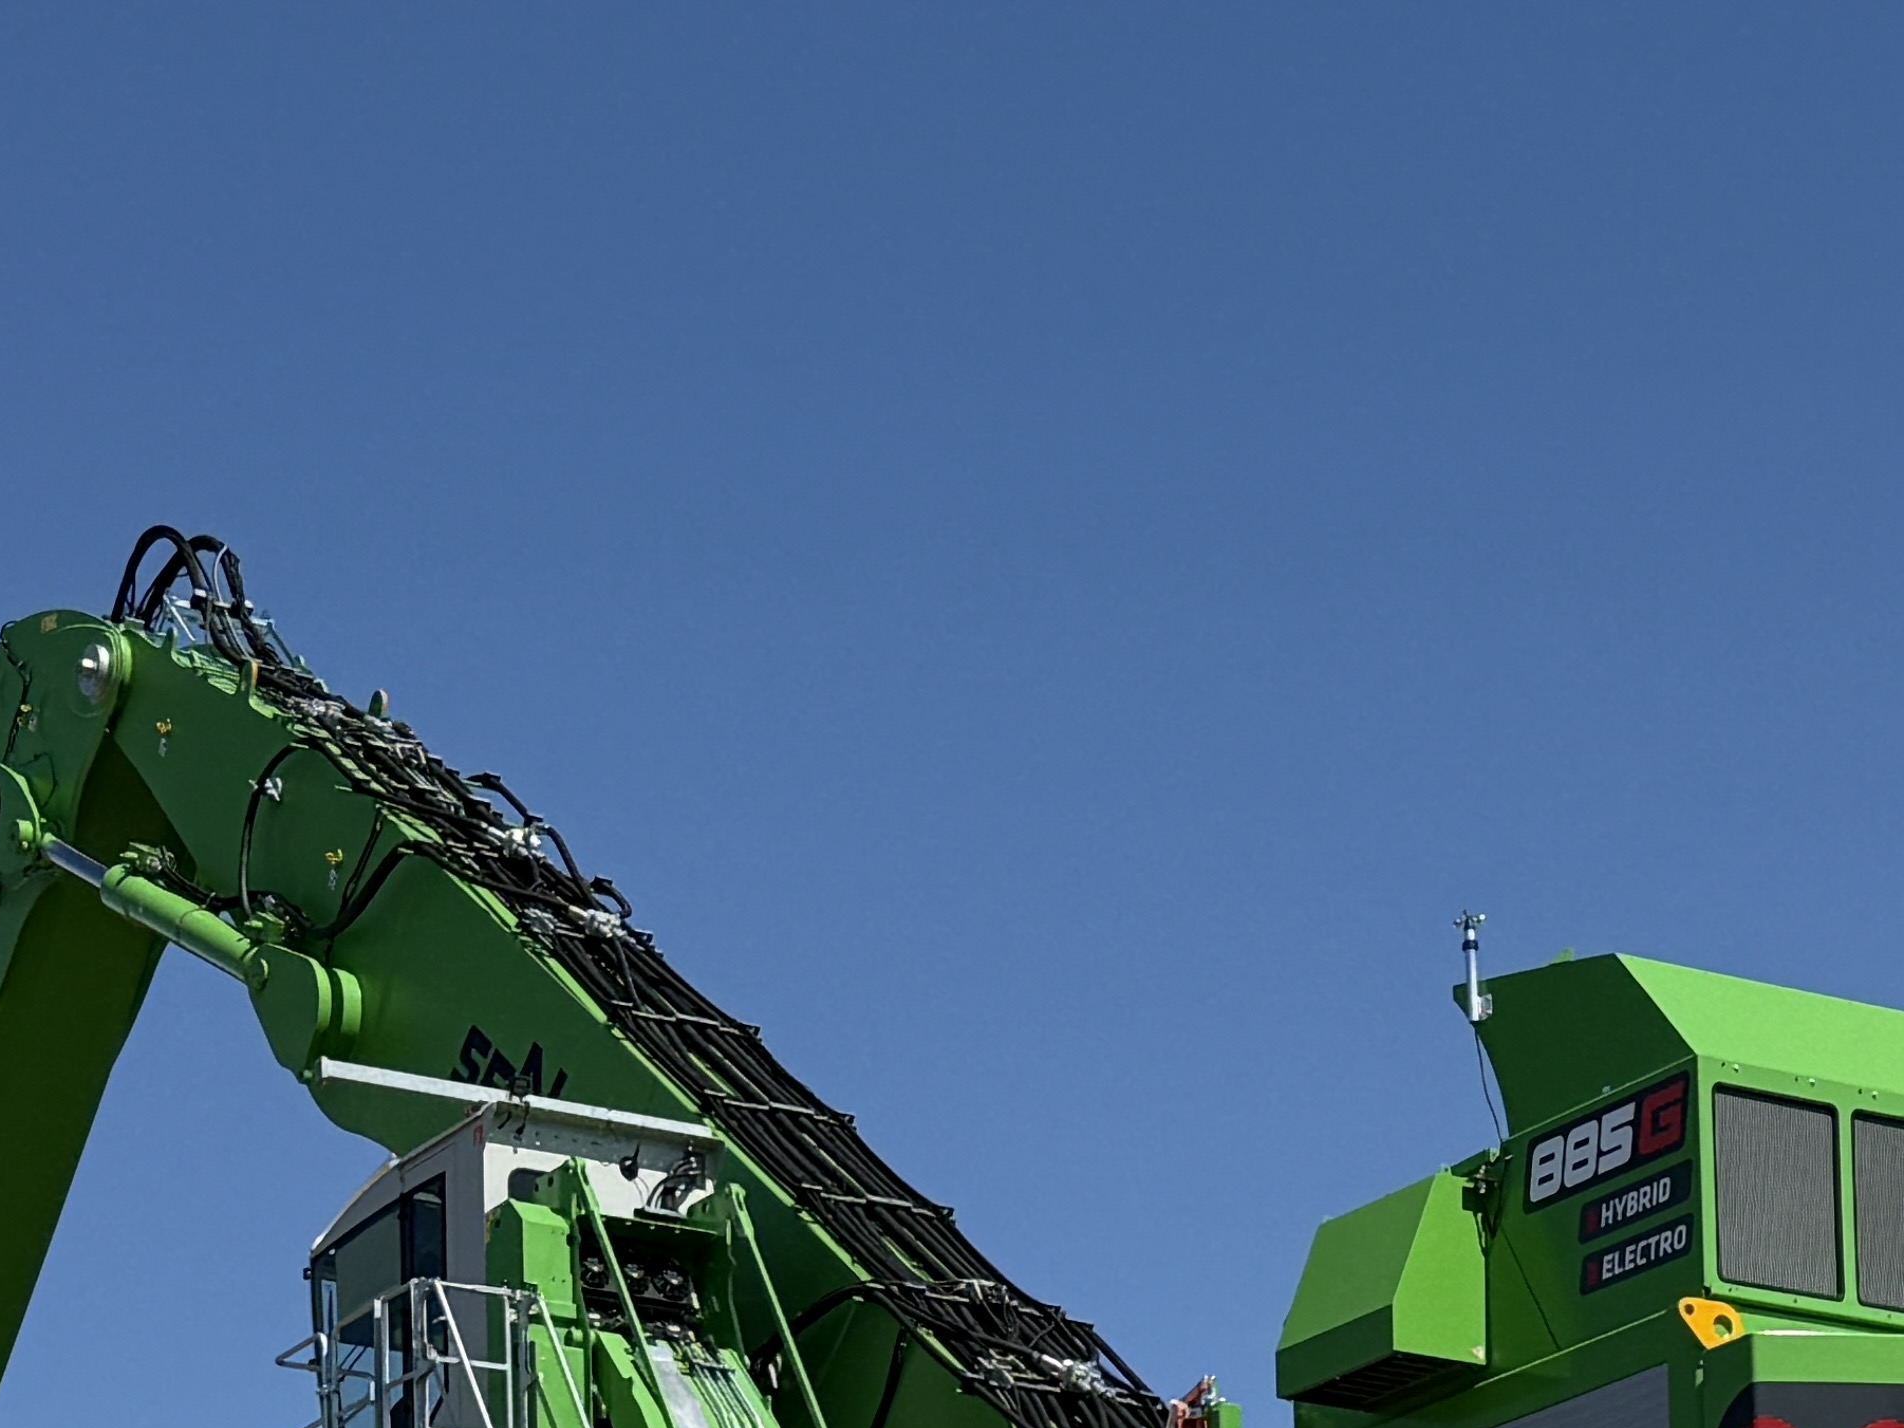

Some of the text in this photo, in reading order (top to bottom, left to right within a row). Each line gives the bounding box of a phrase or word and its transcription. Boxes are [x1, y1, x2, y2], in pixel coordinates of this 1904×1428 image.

[1529, 1080, 1686, 1203] 885G
[1600, 1176, 1671, 1228] HYBRID
[1601, 1224, 1687, 1281] ELECTRO
